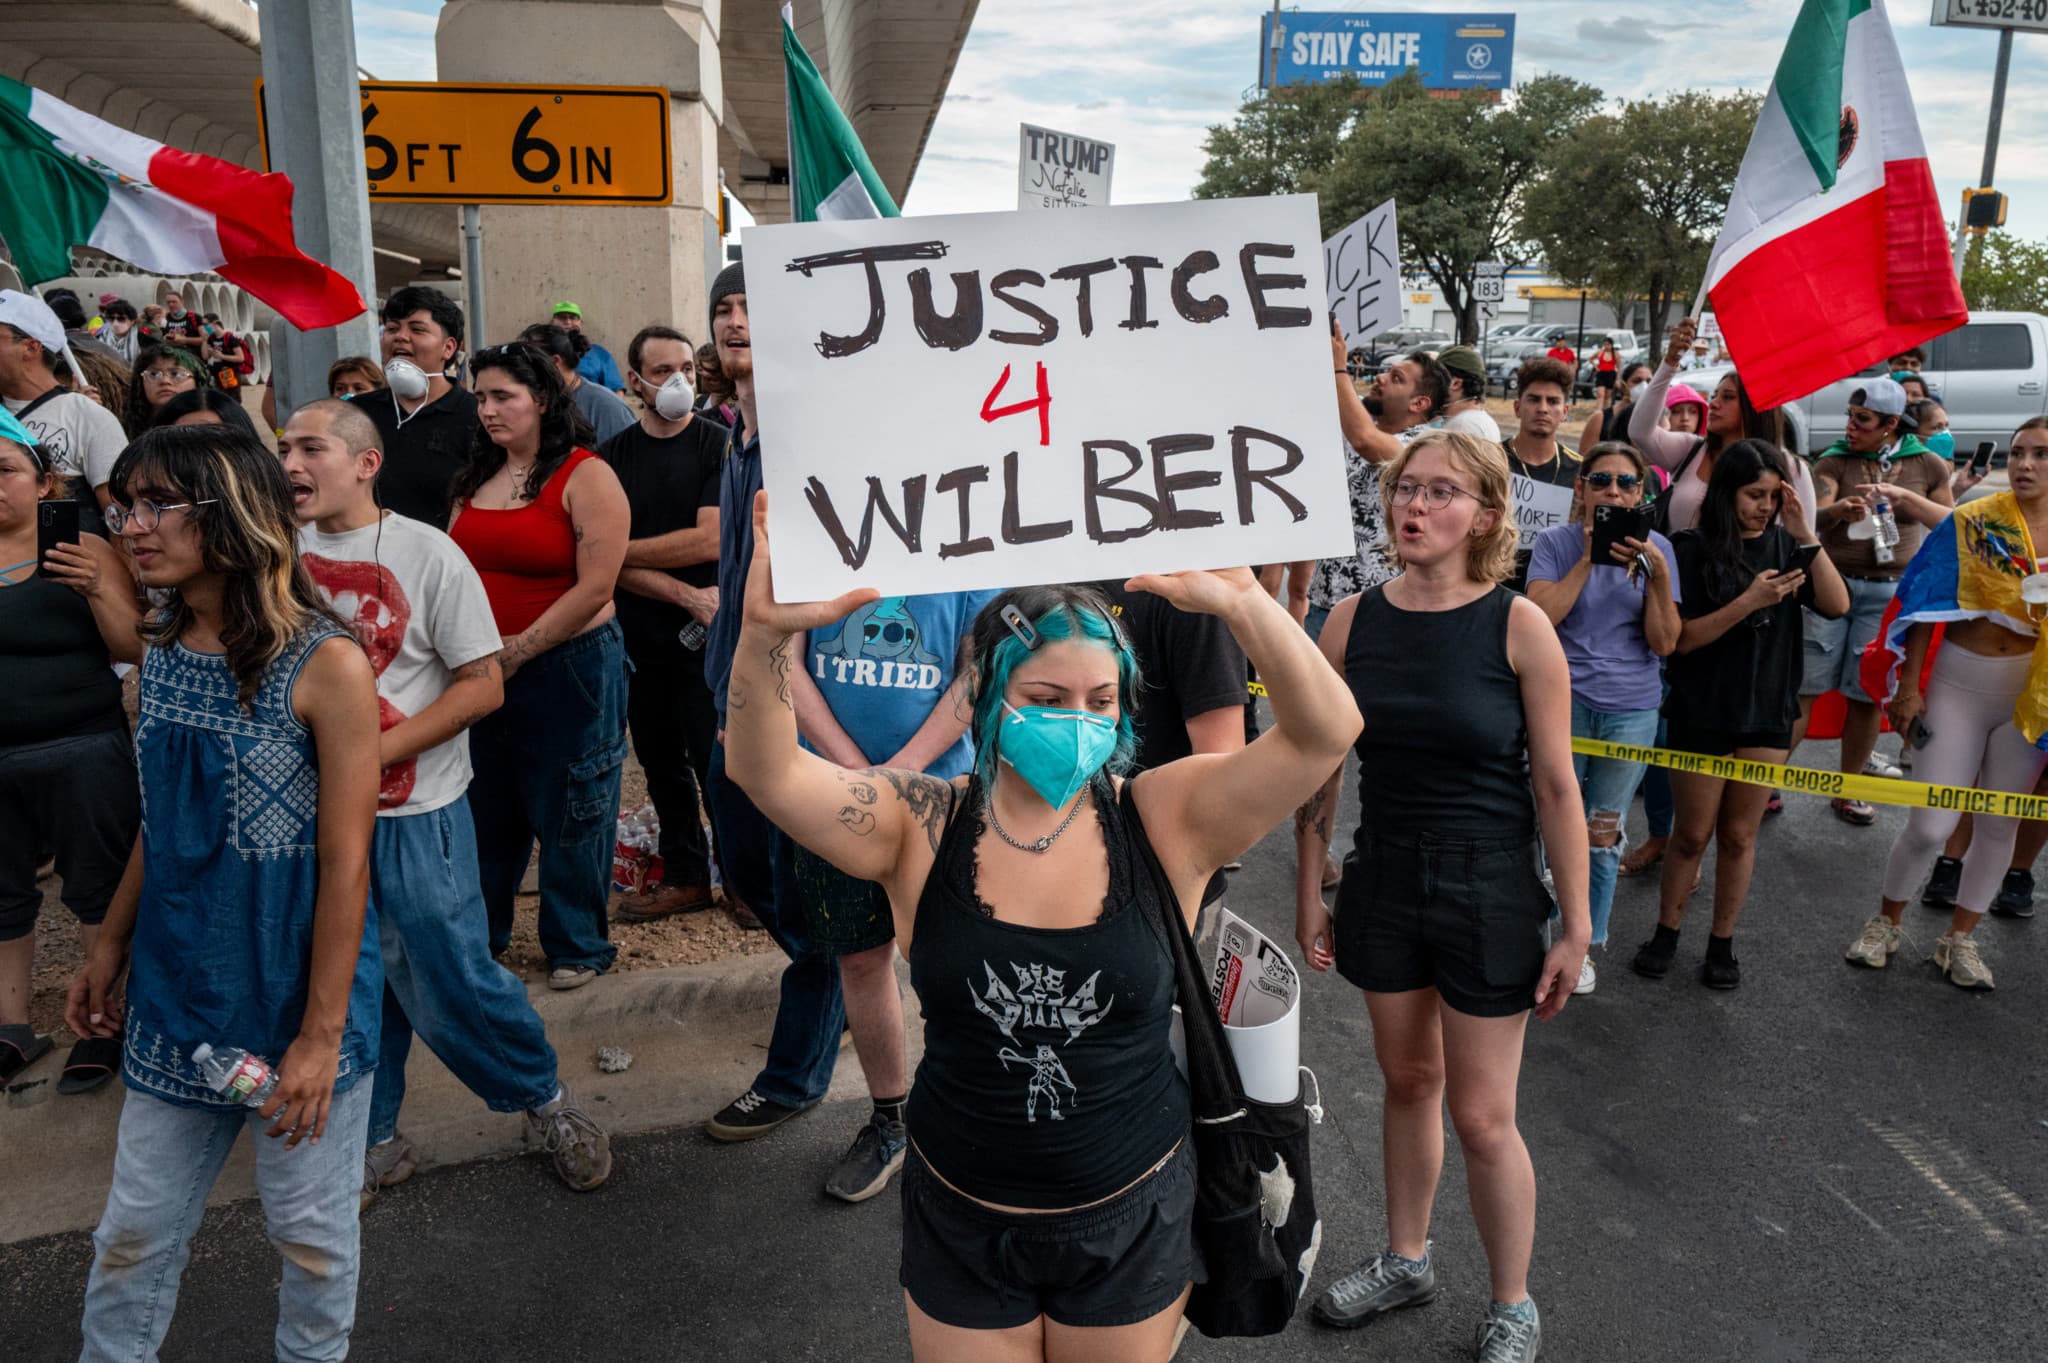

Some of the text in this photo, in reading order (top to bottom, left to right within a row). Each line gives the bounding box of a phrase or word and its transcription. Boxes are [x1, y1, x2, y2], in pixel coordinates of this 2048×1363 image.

[1344, 19, 1371, 28] Y'ALL
[1292, 32, 1421, 67] STAY SAFE
[1323, 71, 1386, 80] DO THERE
[1027, 128, 1109, 176] TRUMP
[1031, 163, 1088, 200] Natalie
[1042, 197, 1088, 208] SITT
[785, 240, 1312, 360] JUSTICE
[1477, 281, 1500, 297] 183
[980, 360, 1053, 446] 4
[804, 425, 1309, 571] WILBER
[1510, 476, 1535, 502] NO
[815, 653, 942, 690] I TRIED
